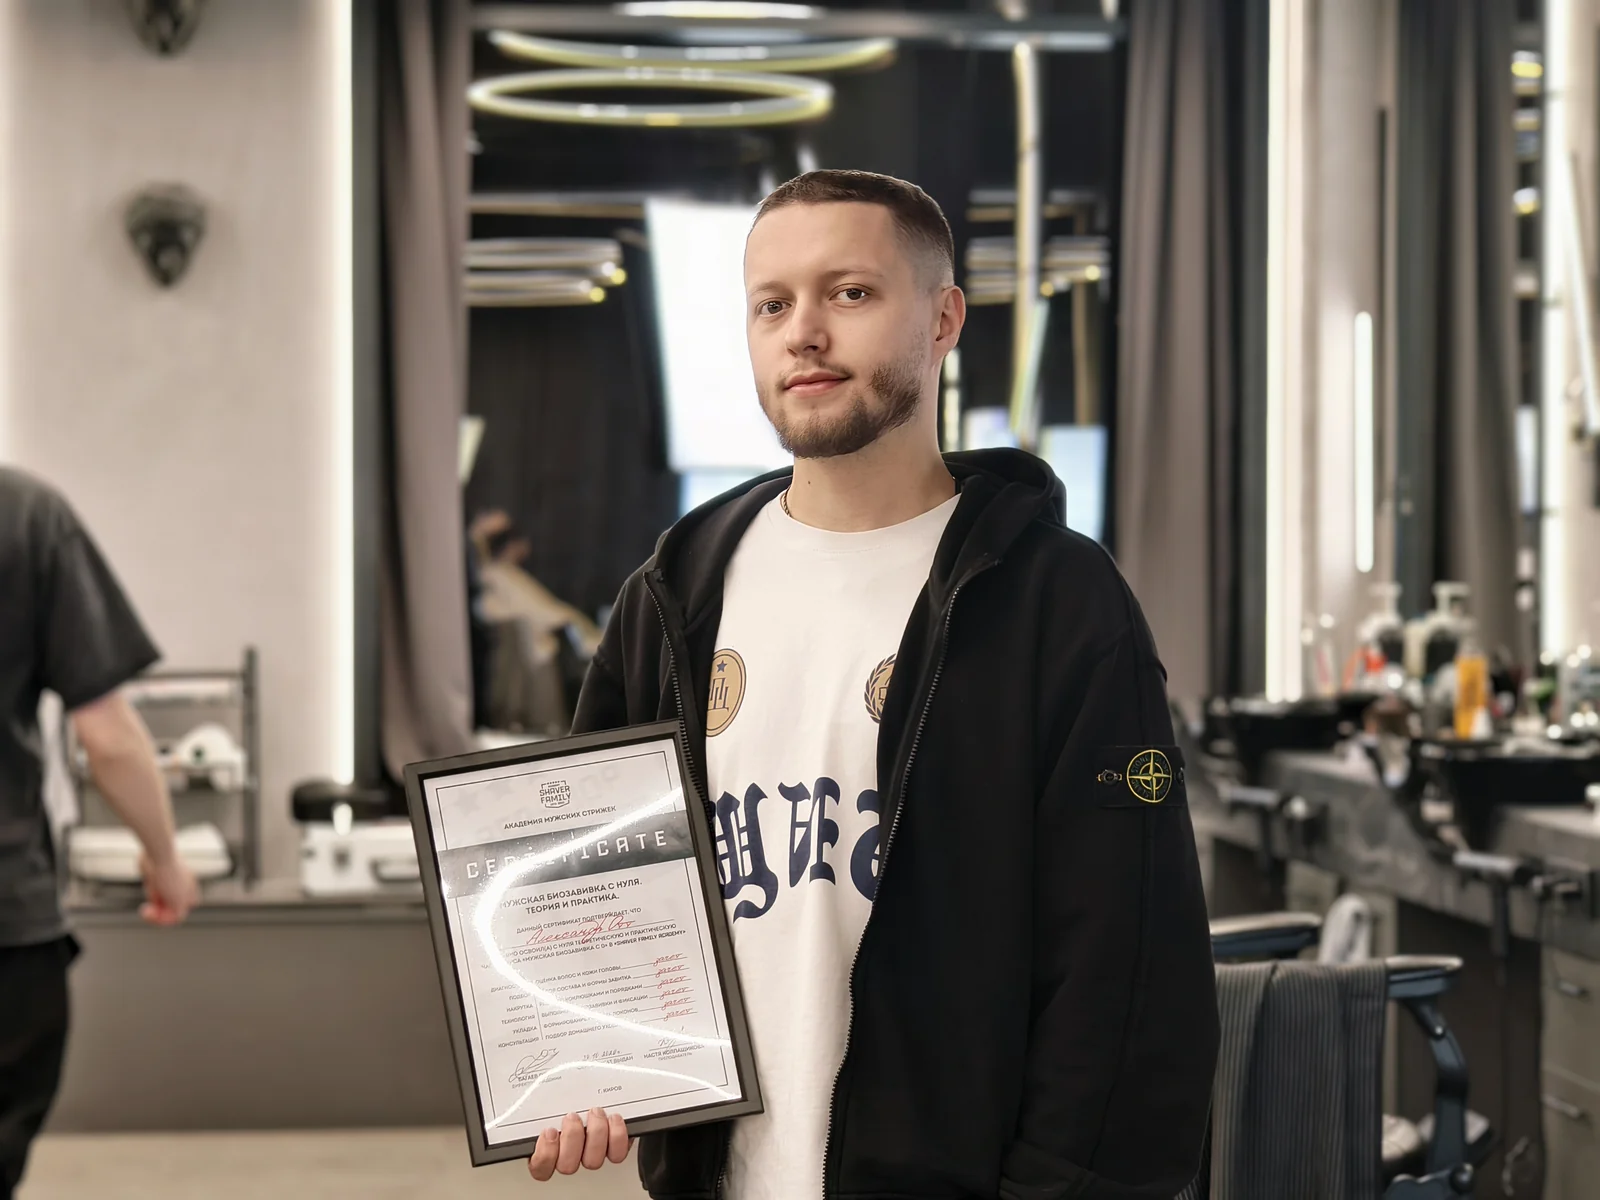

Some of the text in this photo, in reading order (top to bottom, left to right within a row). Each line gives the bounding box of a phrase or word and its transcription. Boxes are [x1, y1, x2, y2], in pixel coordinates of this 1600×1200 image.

[539, 785, 571, 797] SHAVER
[540, 792, 571, 804] FAMILY
[504, 805, 617, 830] АКАДЕМИЯ МУЖСКИХ СТРИЖЕК
[546, 884, 607, 901] БИОЗАВИВКА
[607, 882, 616, 890] С
[616, 878, 643, 889] НУЛЯ.
[525, 892, 620, 915] ТЕОРИЯ И ПРАКТИКА.
[516, 923, 543, 934] ДАННЫЙ
[543, 917, 581, 929] СЕРТИФИКАТ
[518, 945, 553, 956] ОСВОИЛ(А)
[558, 941, 574, 949] НУЛЯ
[630, 923, 677, 936] ПРАКТИЧЕСКУЮ
[555, 945, 595, 957] БИОЗАВИВКА
[557, 972, 577, 981] ВОЛОС
[598, 965, 621, 974] ГОЛОВЫ
[556, 983, 582, 992] СОСТАВА
[587, 979, 608, 987] ФОРМЫ
[608, 975, 632, 983] ЗАВИТКА
[501, 1014, 536, 1025] ТЕХНОЛОГИЯ
[618, 995, 648, 1004] ФИКСАЦИИ
[506, 1003, 533, 1012] НАКРУТКА
[498, 1036, 540, 1048] КОНСУЛЬТАЦИЯ
[545, 1031, 568, 1040] ПОДБОР
[568, 1025, 602, 1036] ДОМАШНЕГО
[512, 1026, 538, 1034] УКЛАДКА
[602, 1085, 622, 1094] КИРОВ
